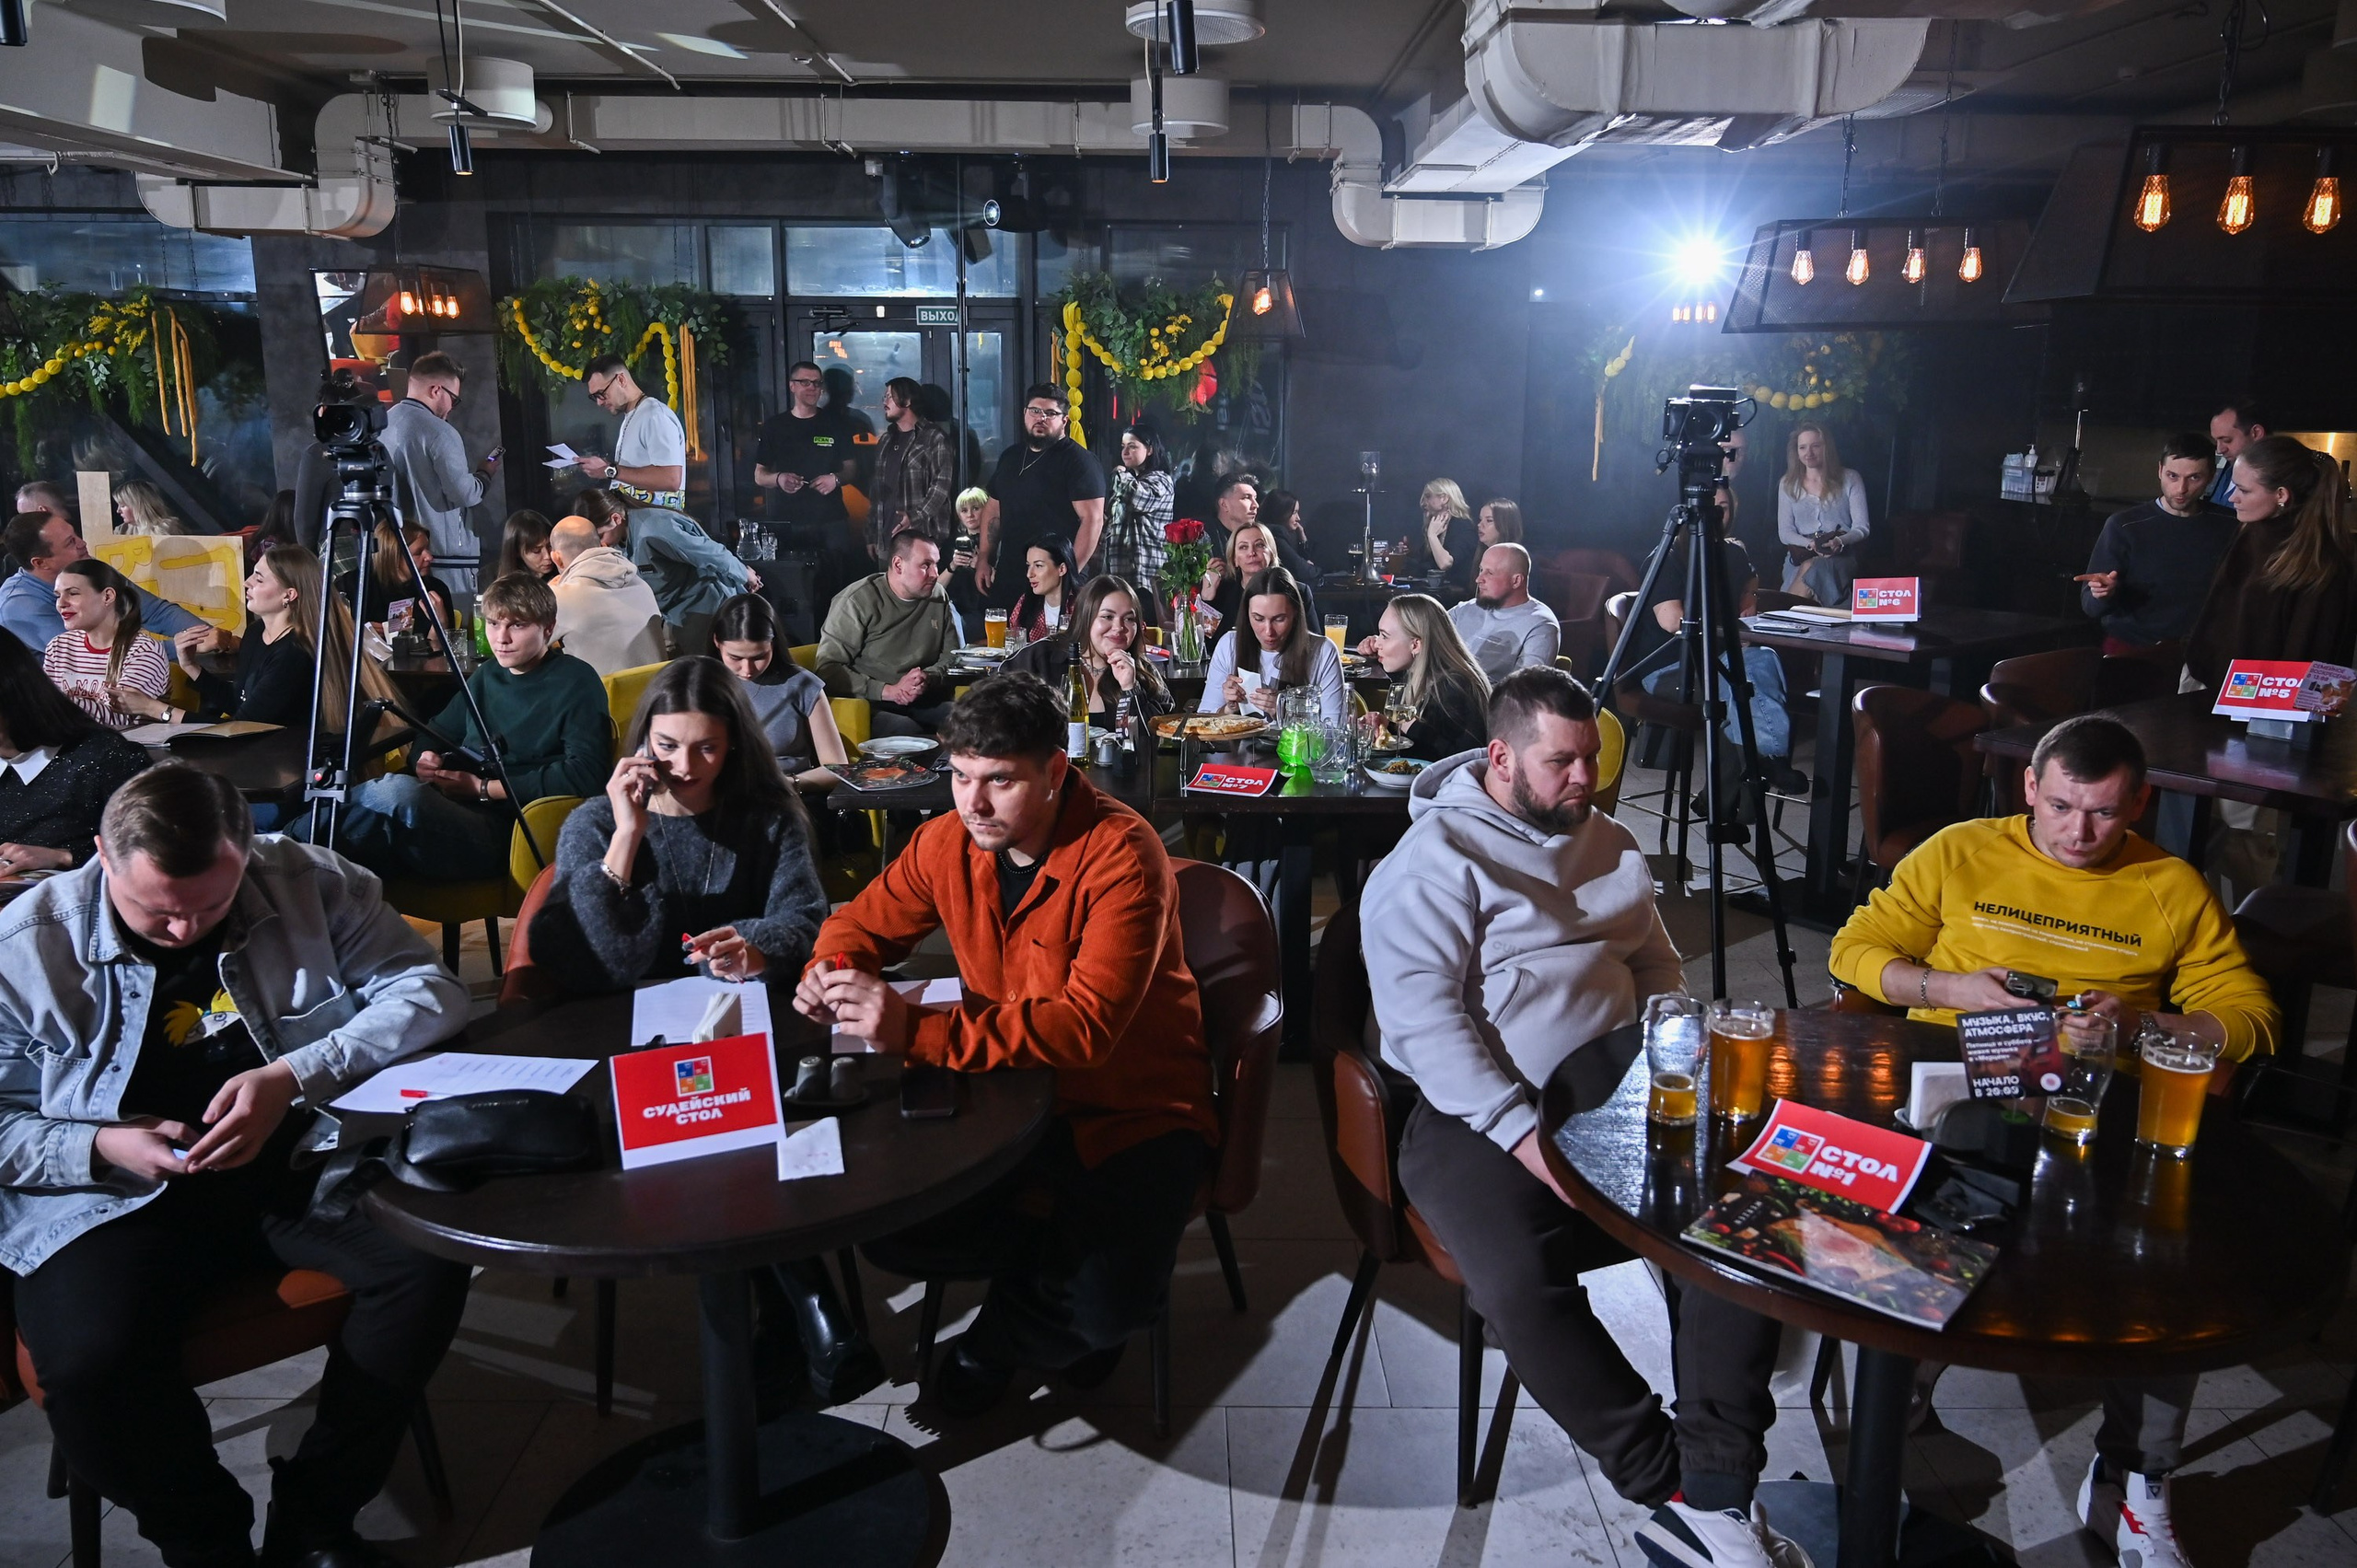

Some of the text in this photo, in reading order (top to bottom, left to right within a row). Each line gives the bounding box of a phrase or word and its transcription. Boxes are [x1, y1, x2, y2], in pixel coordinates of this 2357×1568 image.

[921, 310, 958, 321] ВЫХО
[1878, 589, 1911, 598] СТОЛ
[2258, 688, 2291, 699] №5
[1225, 777, 1263, 785] СТОЛ
[1974, 901, 2142, 947] НЕЛИЦЕПРИЯТНЫЙ
[1961, 1011, 2049, 1028] МУЗЫКА, ВКУС,
[1964, 1023, 2034, 1038] АТМОСФЕРА
[1972, 1075, 2019, 1087] НАЧАЛО
[1974, 1088, 1982, 1098] В
[643, 1087, 751, 1119] СУДЕЙСКИЙ
[675, 1108, 723, 1125] СТОЛ
[1820, 1145, 1898, 1182] СТОЛ
[1808, 1160, 1857, 1186] №1
